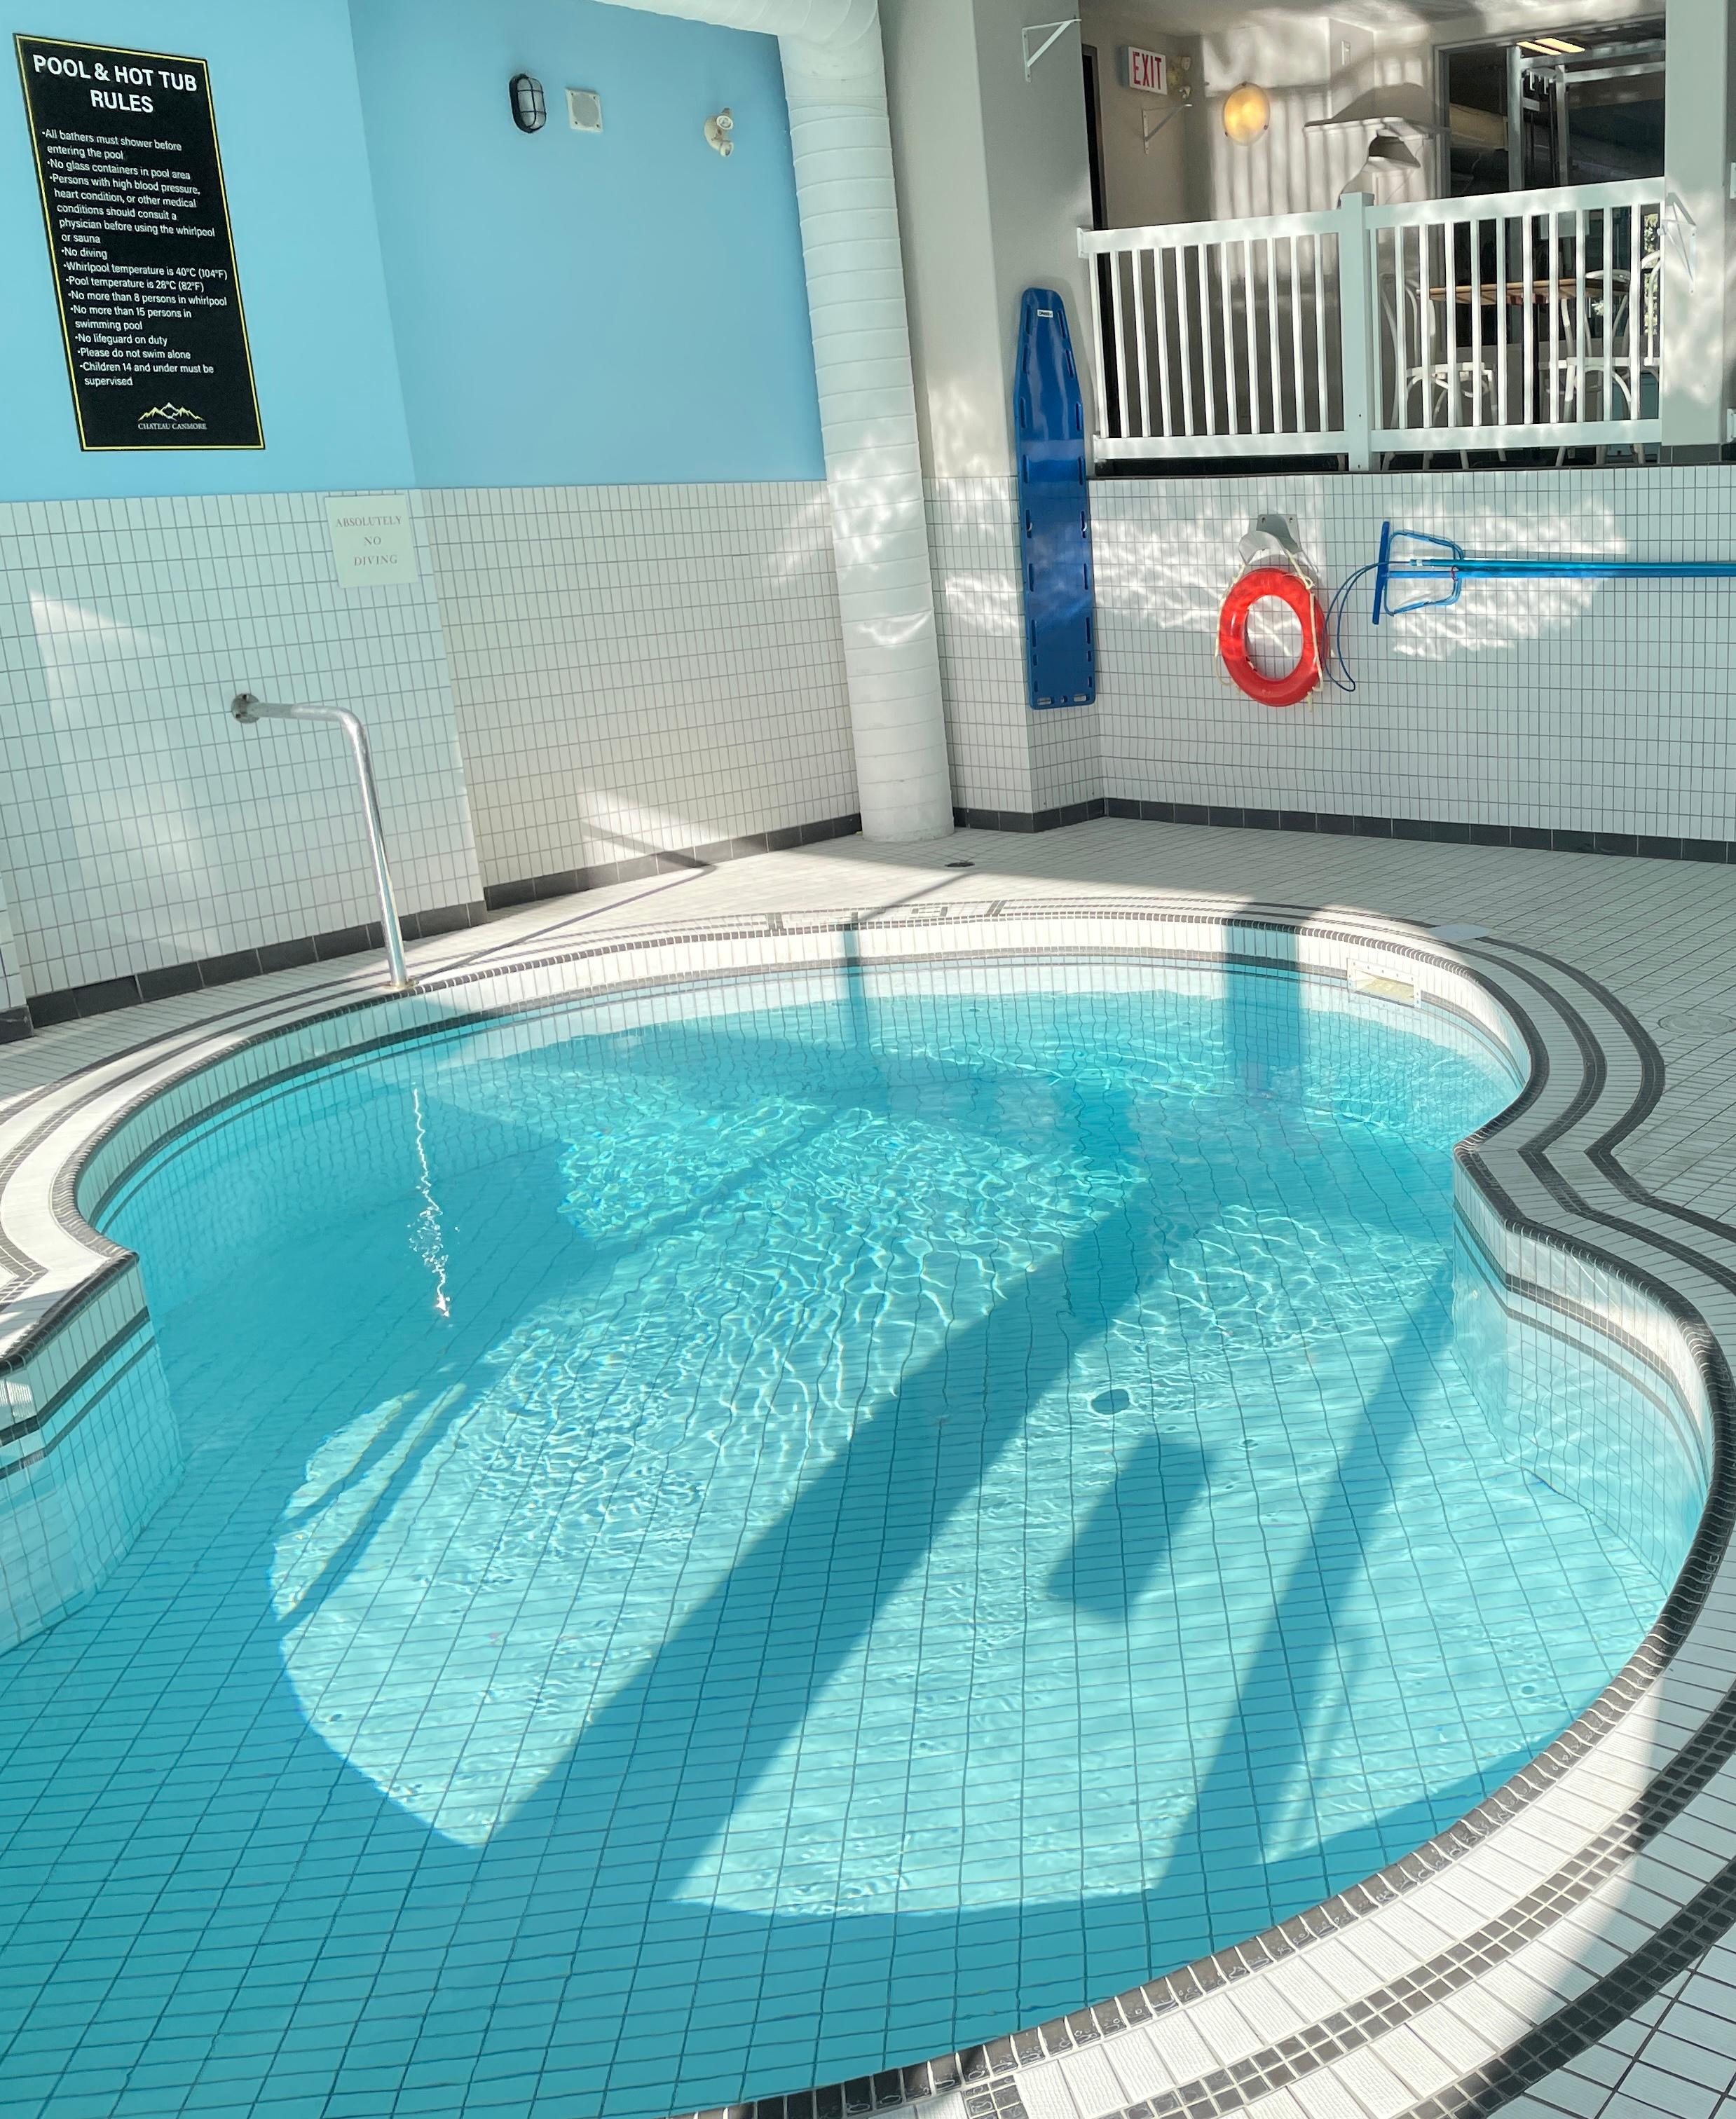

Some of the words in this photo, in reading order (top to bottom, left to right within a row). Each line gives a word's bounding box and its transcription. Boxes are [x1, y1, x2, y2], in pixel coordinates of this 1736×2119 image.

[33, 55, 90, 79] POOL
[95, 62, 110, 81] &
[114, 65, 153, 86] HOT
[158, 70, 197, 91] TUB
[1133, 51, 1161, 90] EXIT
[90, 90, 153, 113] RULES
[60, 130, 94, 142] bathers
[97, 135, 118, 146] must
[121, 137, 152, 148] shower
[154, 139, 182, 151] before
[48, 145, 85, 158] entering
[88, 148, 102, 157] the
[104, 151, 123, 161] pool
[66, 161, 90, 172] glass
[92, 164, 138, 175] containers
[140, 167, 149, 176] in
[151, 168, 169, 179] pool
[172, 171, 190, 180] area
[91, 177, 110, 187] with
[113, 179, 132, 190] high
[135, 181, 158, 191] blood
[161, 184, 200, 196] pressure,
[54, 188, 78, 198] heart
[81, 191, 125, 204] condition,
[138, 196, 160, 205] other
[163, 198, 196, 208] medical
[57, 204, 104, 215] conditions
[107, 207, 135, 218] should
[138, 210, 169, 220] consult
[59, 219, 102, 230] physician
[104, 220, 132, 231] before
[135, 224, 158, 235] using
[160, 225, 174, 234] the
[176, 226, 215, 237] whirlpool
[73, 235, 100, 244] sauna
[80, 248, 107, 260] diving
[111, 264, 165, 276] temperature
[167, 267, 174, 275] is
[91, 277, 144, 289] temperature
[112, 293, 132, 301] than
[142, 296, 176, 305] persons
[178, 295, 186, 303] in
[188, 296, 226, 307] whirlpool
[136, 308, 145, 316] 15
[148, 309, 182, 318] persons
[184, 309, 191, 318] in
[75, 320, 121, 331] swimming
[123, 321, 142, 331] pool
[93, 334, 132, 345] lifeguard
[149, 336, 168, 346] duty
[112, 349, 123, 357] do
[126, 350, 140, 358] not
[142, 350, 165, 359] swim
[168, 350, 191, 359] alone
[123, 363, 131, 371] 14
[135, 364, 151, 372] and
[153, 364, 178, 372] under
[180, 364, 201, 373] must
[203, 364, 214, 373] be
[85, 376, 132, 387] supervised
[336, 516, 401, 527] ABSOLUTELY
[364, 536, 381, 545] NO
[354, 554, 397, 566] DIVING
